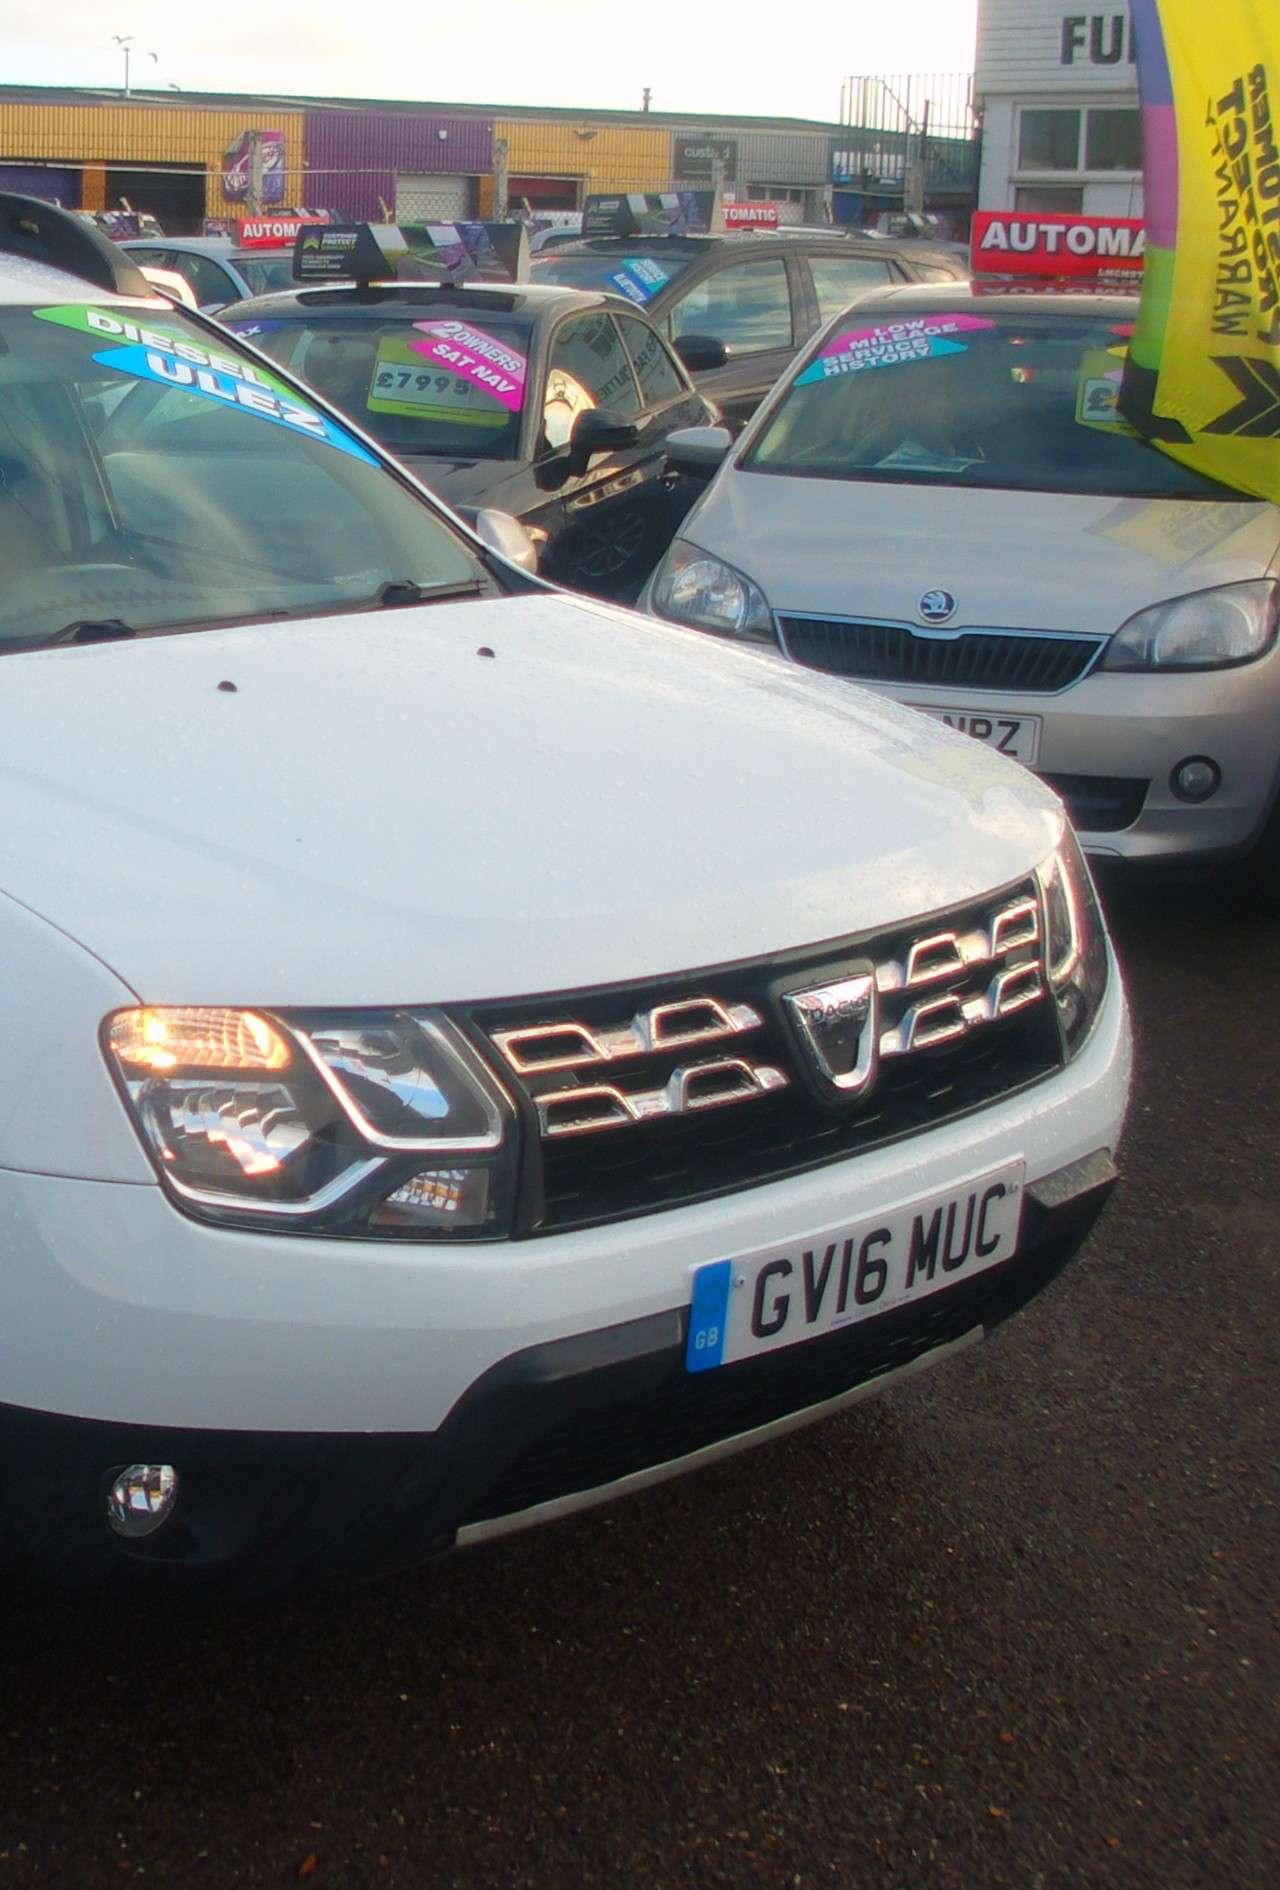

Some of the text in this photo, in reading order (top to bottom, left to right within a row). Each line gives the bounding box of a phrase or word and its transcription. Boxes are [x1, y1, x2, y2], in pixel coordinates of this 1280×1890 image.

[980, 221, 1146, 258] AUTOMA
[849, 322, 959, 350] MILEAGE
[873, 320, 925, 337] LOW
[86, 311, 256, 381] DIESEL
[823, 336, 929, 364] SERVICE
[823, 348, 931, 376] HISTORY
[432, 343, 517, 393] SAT NAV
[146, 352, 329, 438] ULEZ
[751, 1182, 1006, 1338] GV16 MUC
[695, 1326, 719, 1351] GB
